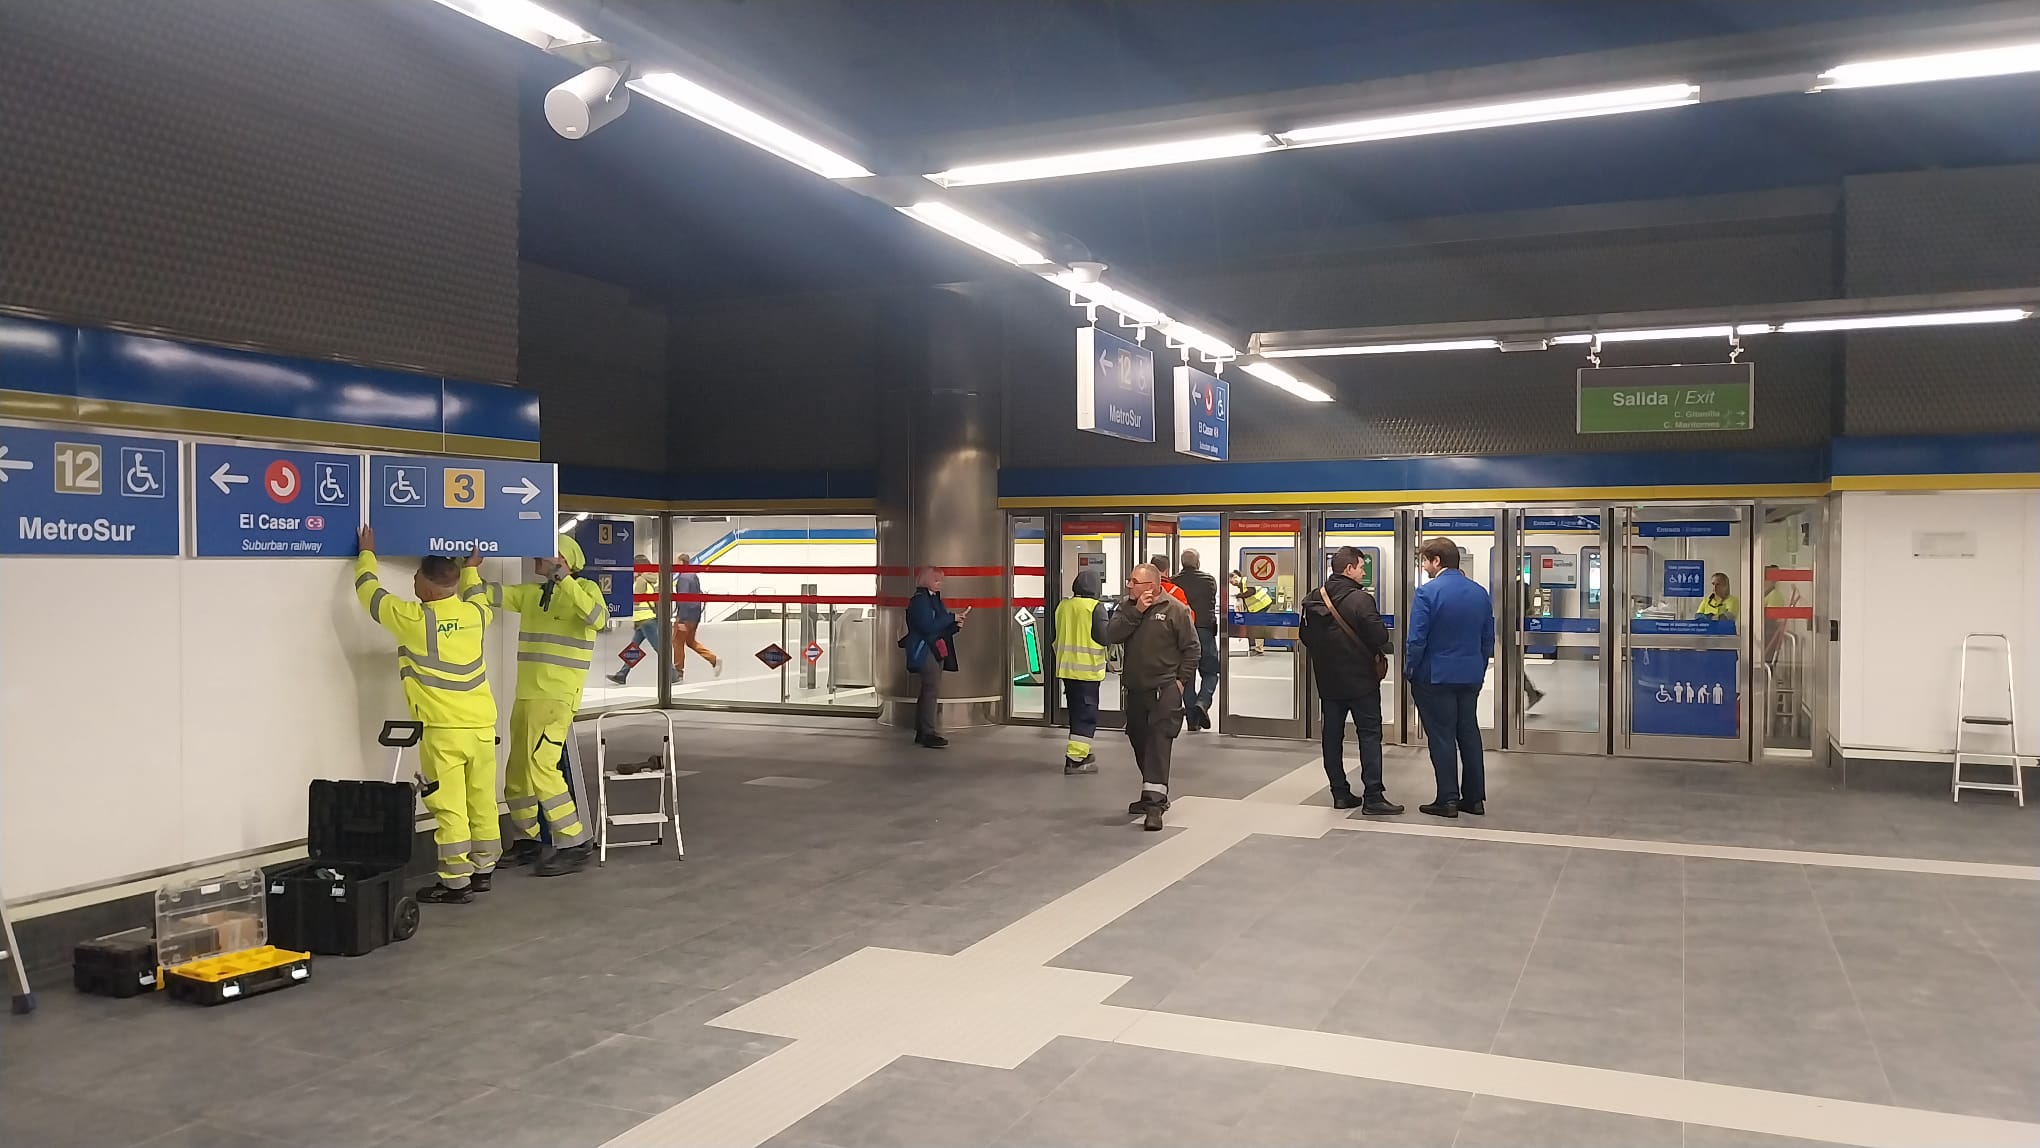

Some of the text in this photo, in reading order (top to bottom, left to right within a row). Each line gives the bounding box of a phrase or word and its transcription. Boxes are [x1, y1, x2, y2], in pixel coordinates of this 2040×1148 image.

[1119, 354, 1131, 385] 12
[1612, 391, 1669, 407] Salida
[1685, 390, 1716, 405] Exit
[1109, 403, 1142, 428] MetroSur
[57, 449, 100, 488] 12
[454, 474, 475, 503] 3
[19, 516, 136, 542] MetroSur
[239, 513, 323, 530] El Casar C-3
[602, 526, 609, 541] 3
[241, 538, 322, 553] Suburban railway
[430, 537, 499, 552] Moncloa
[437, 622, 458, 632] API
